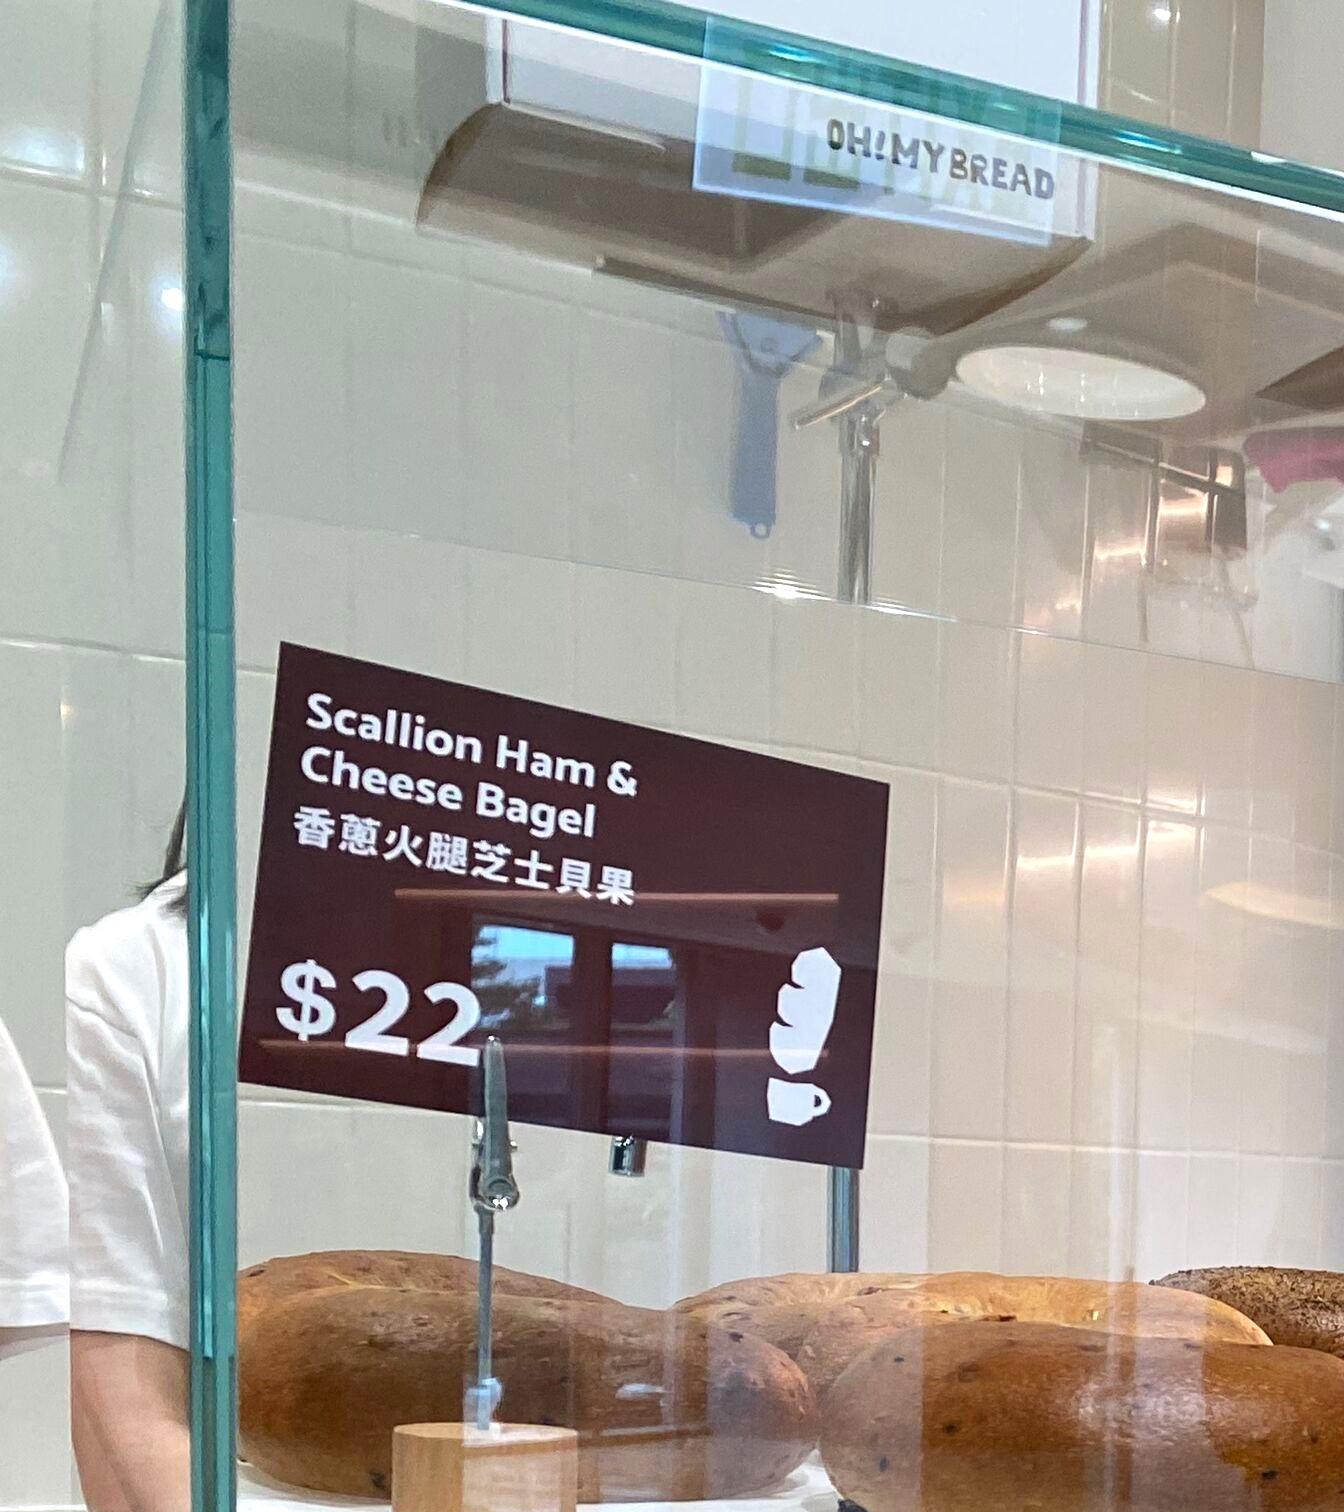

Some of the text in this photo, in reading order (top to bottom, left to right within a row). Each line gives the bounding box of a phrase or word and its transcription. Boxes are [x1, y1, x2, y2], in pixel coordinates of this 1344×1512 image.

[827, 119, 1055, 199] OH!MYBREAD
[301, 746, 597, 839] Cheese Bagel
[306, 692, 639, 797] Scallion Ham &
[276, 958, 481, 1068] $22
